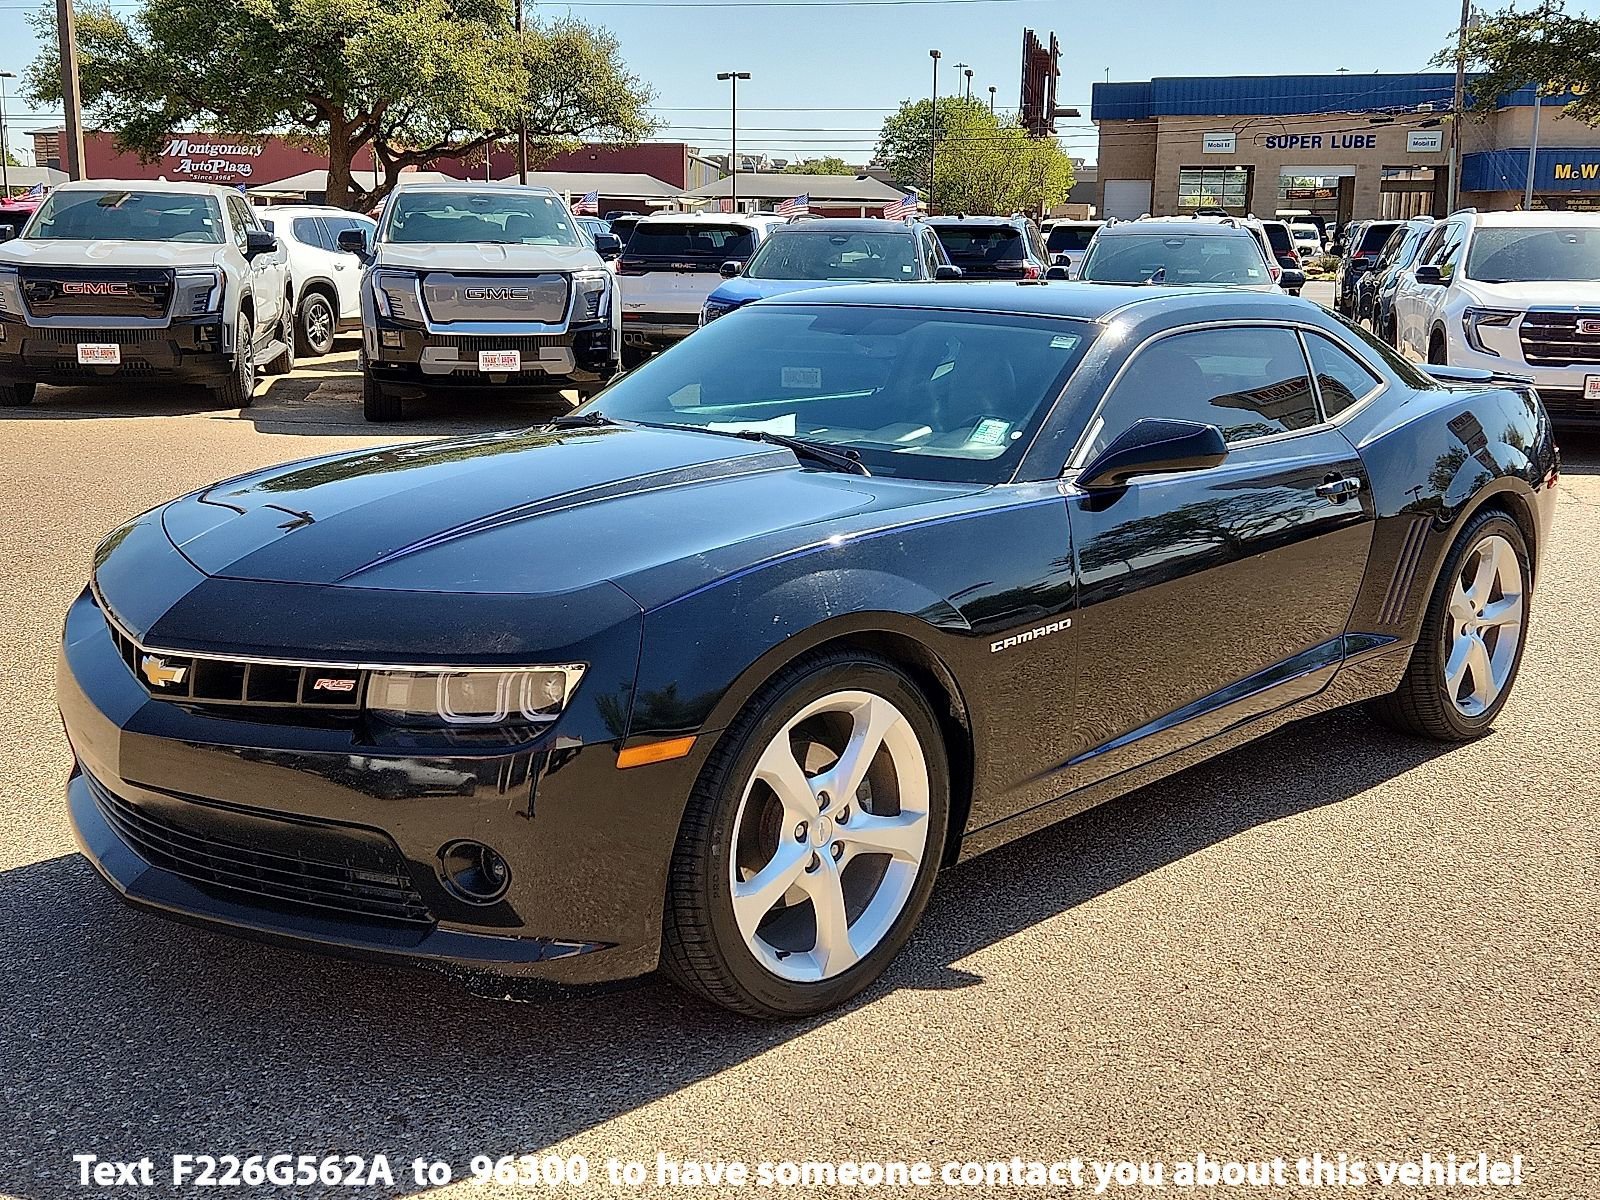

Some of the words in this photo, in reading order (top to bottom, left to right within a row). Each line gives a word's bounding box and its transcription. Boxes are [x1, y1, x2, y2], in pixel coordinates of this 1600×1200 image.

[158, 139, 264, 158] Montgomery
[1265, 134, 1323, 149] SUPER
[1330, 134, 1377, 149] LUBE
[62, 282, 129, 295] GMC
[464, 287, 529, 300] GMC
[990, 618, 1072, 653] CAMARO
[313, 678, 356, 691] RS
